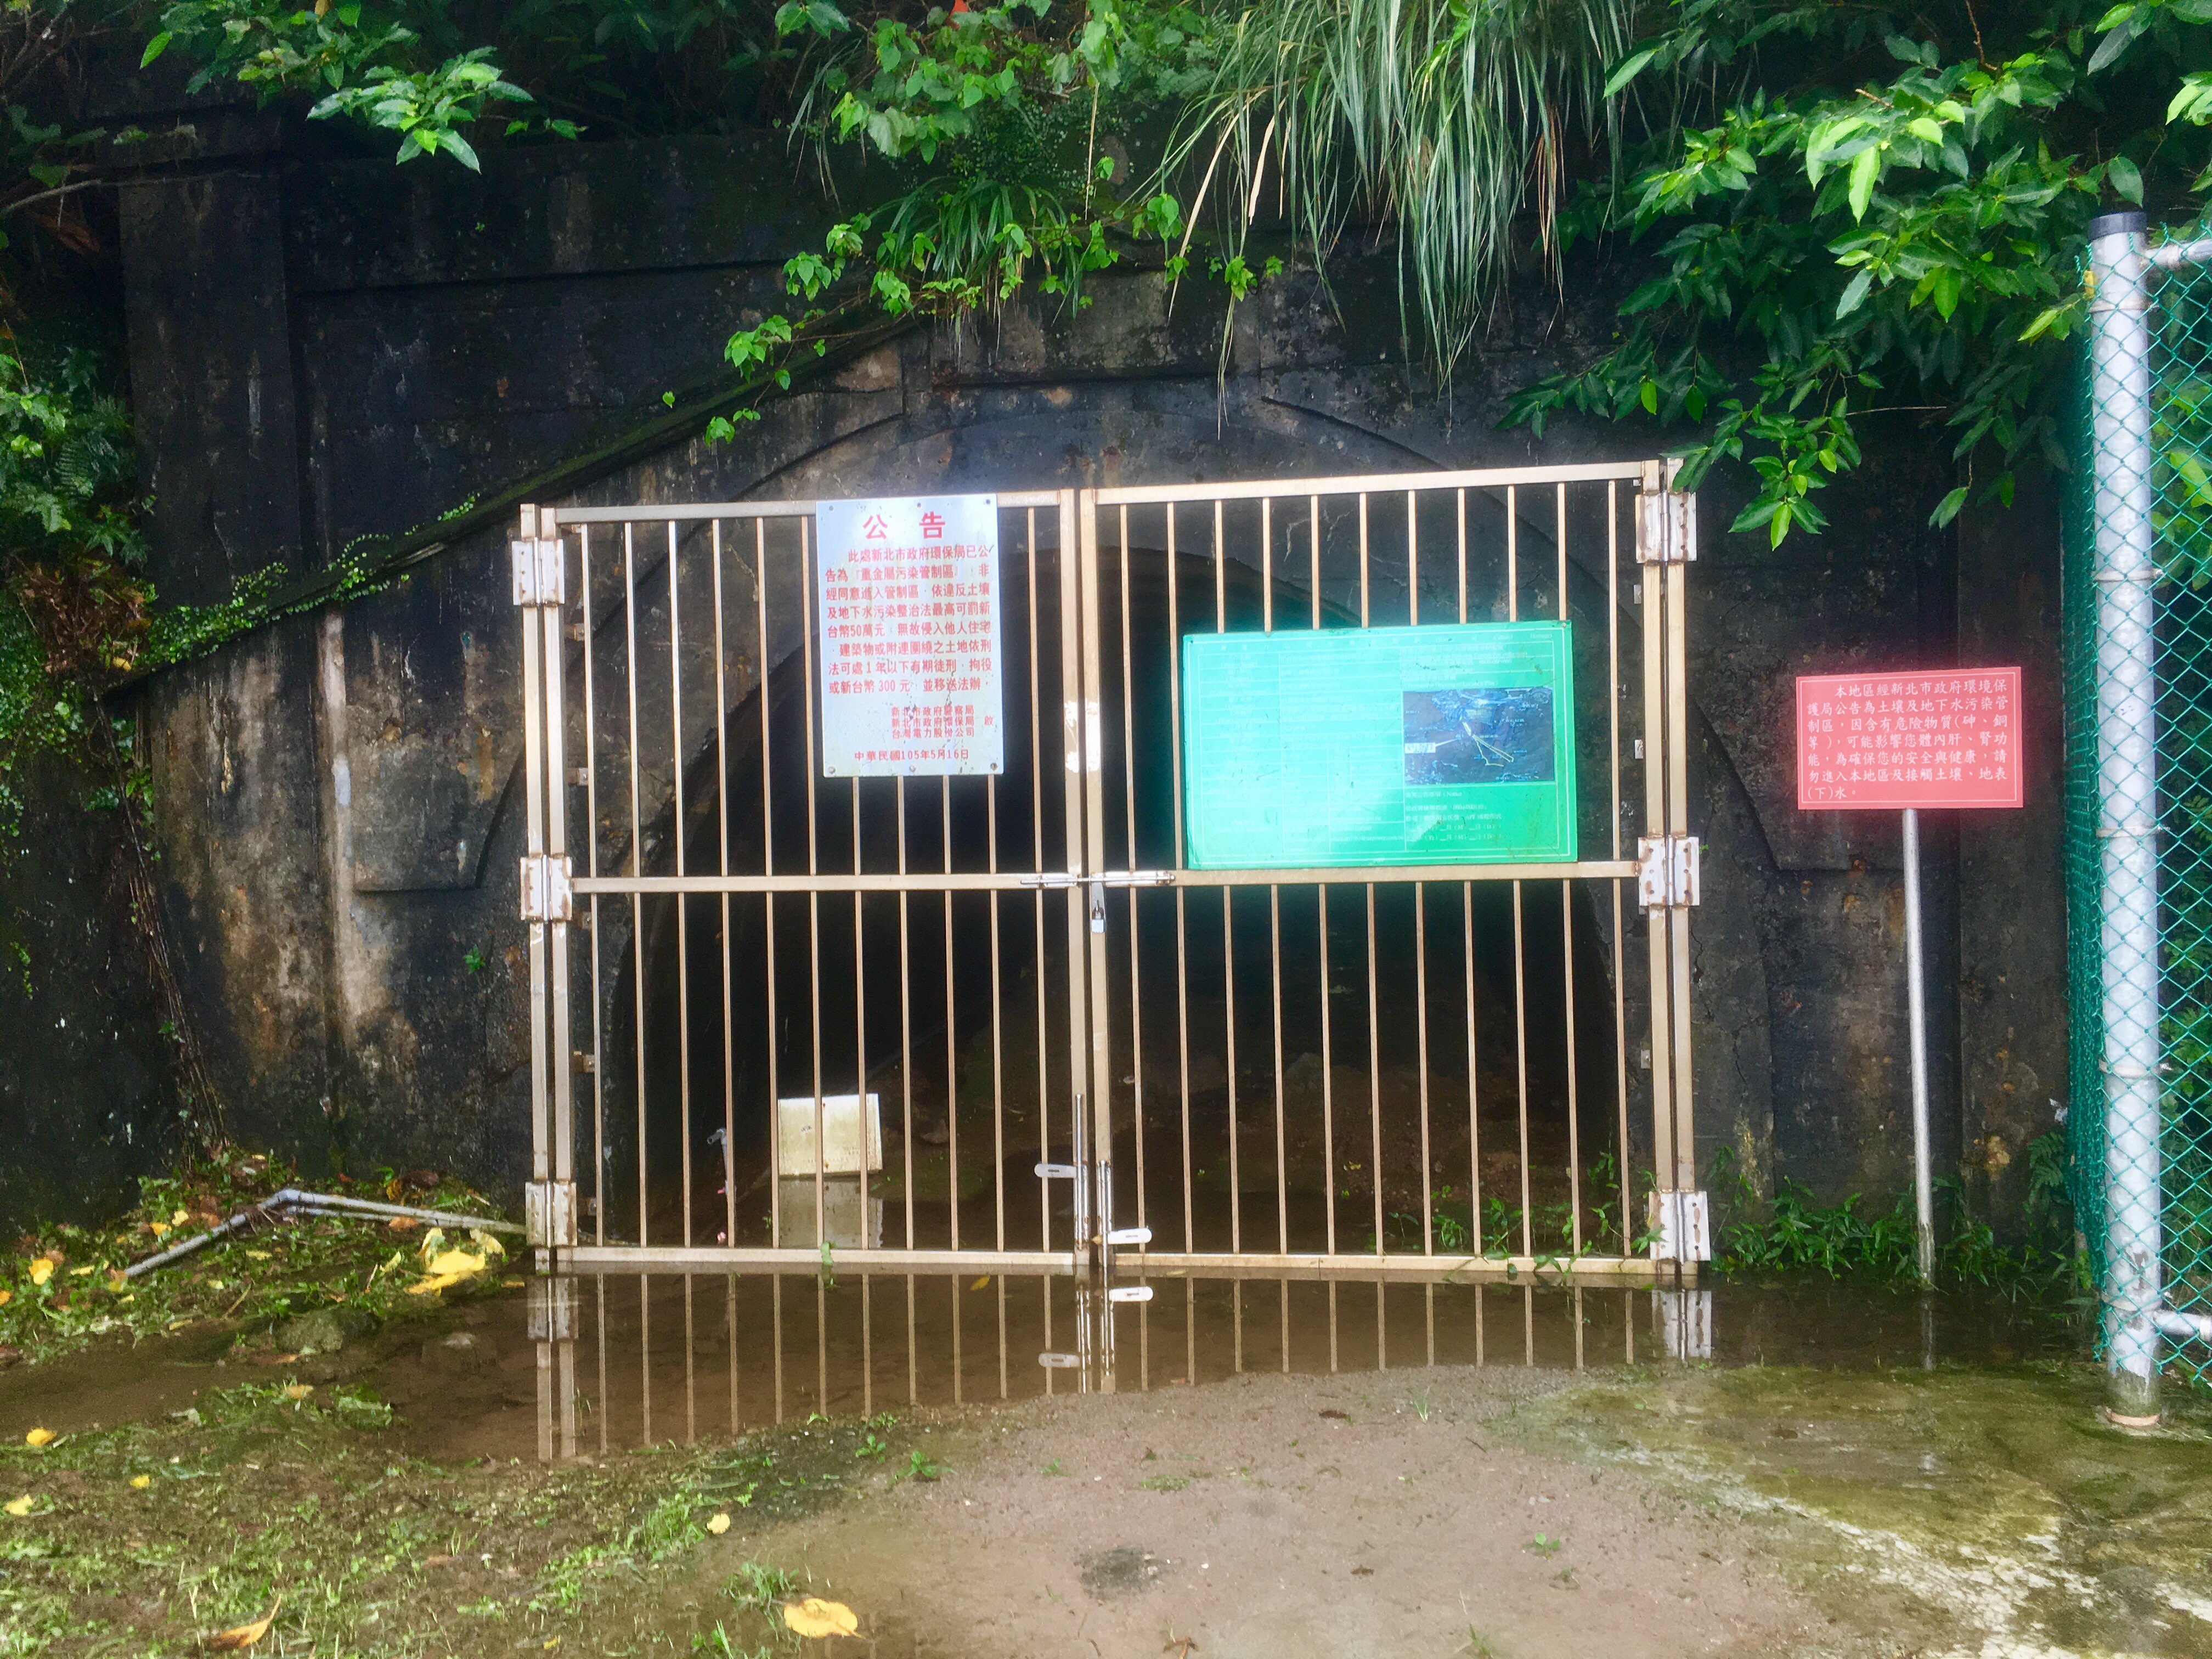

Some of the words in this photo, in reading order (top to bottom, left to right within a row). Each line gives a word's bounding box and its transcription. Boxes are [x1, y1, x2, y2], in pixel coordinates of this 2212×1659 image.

[862, 511, 946, 540] 公告
[849, 545, 989, 563] 此處新北市政府環保局已公
[827, 601, 990, 619] 及地下水污染整治法最高可罰新
[1835, 679, 2007, 698] 本地區經新北市政府環境保
[1808, 696, 2008, 716] 護局公告為土壤及地下水污染管
[854, 749, 969, 761] 中華民國105年5月16日
[1809, 766, 2007, 784] 勿進入本地區及接觸土壤、地表
